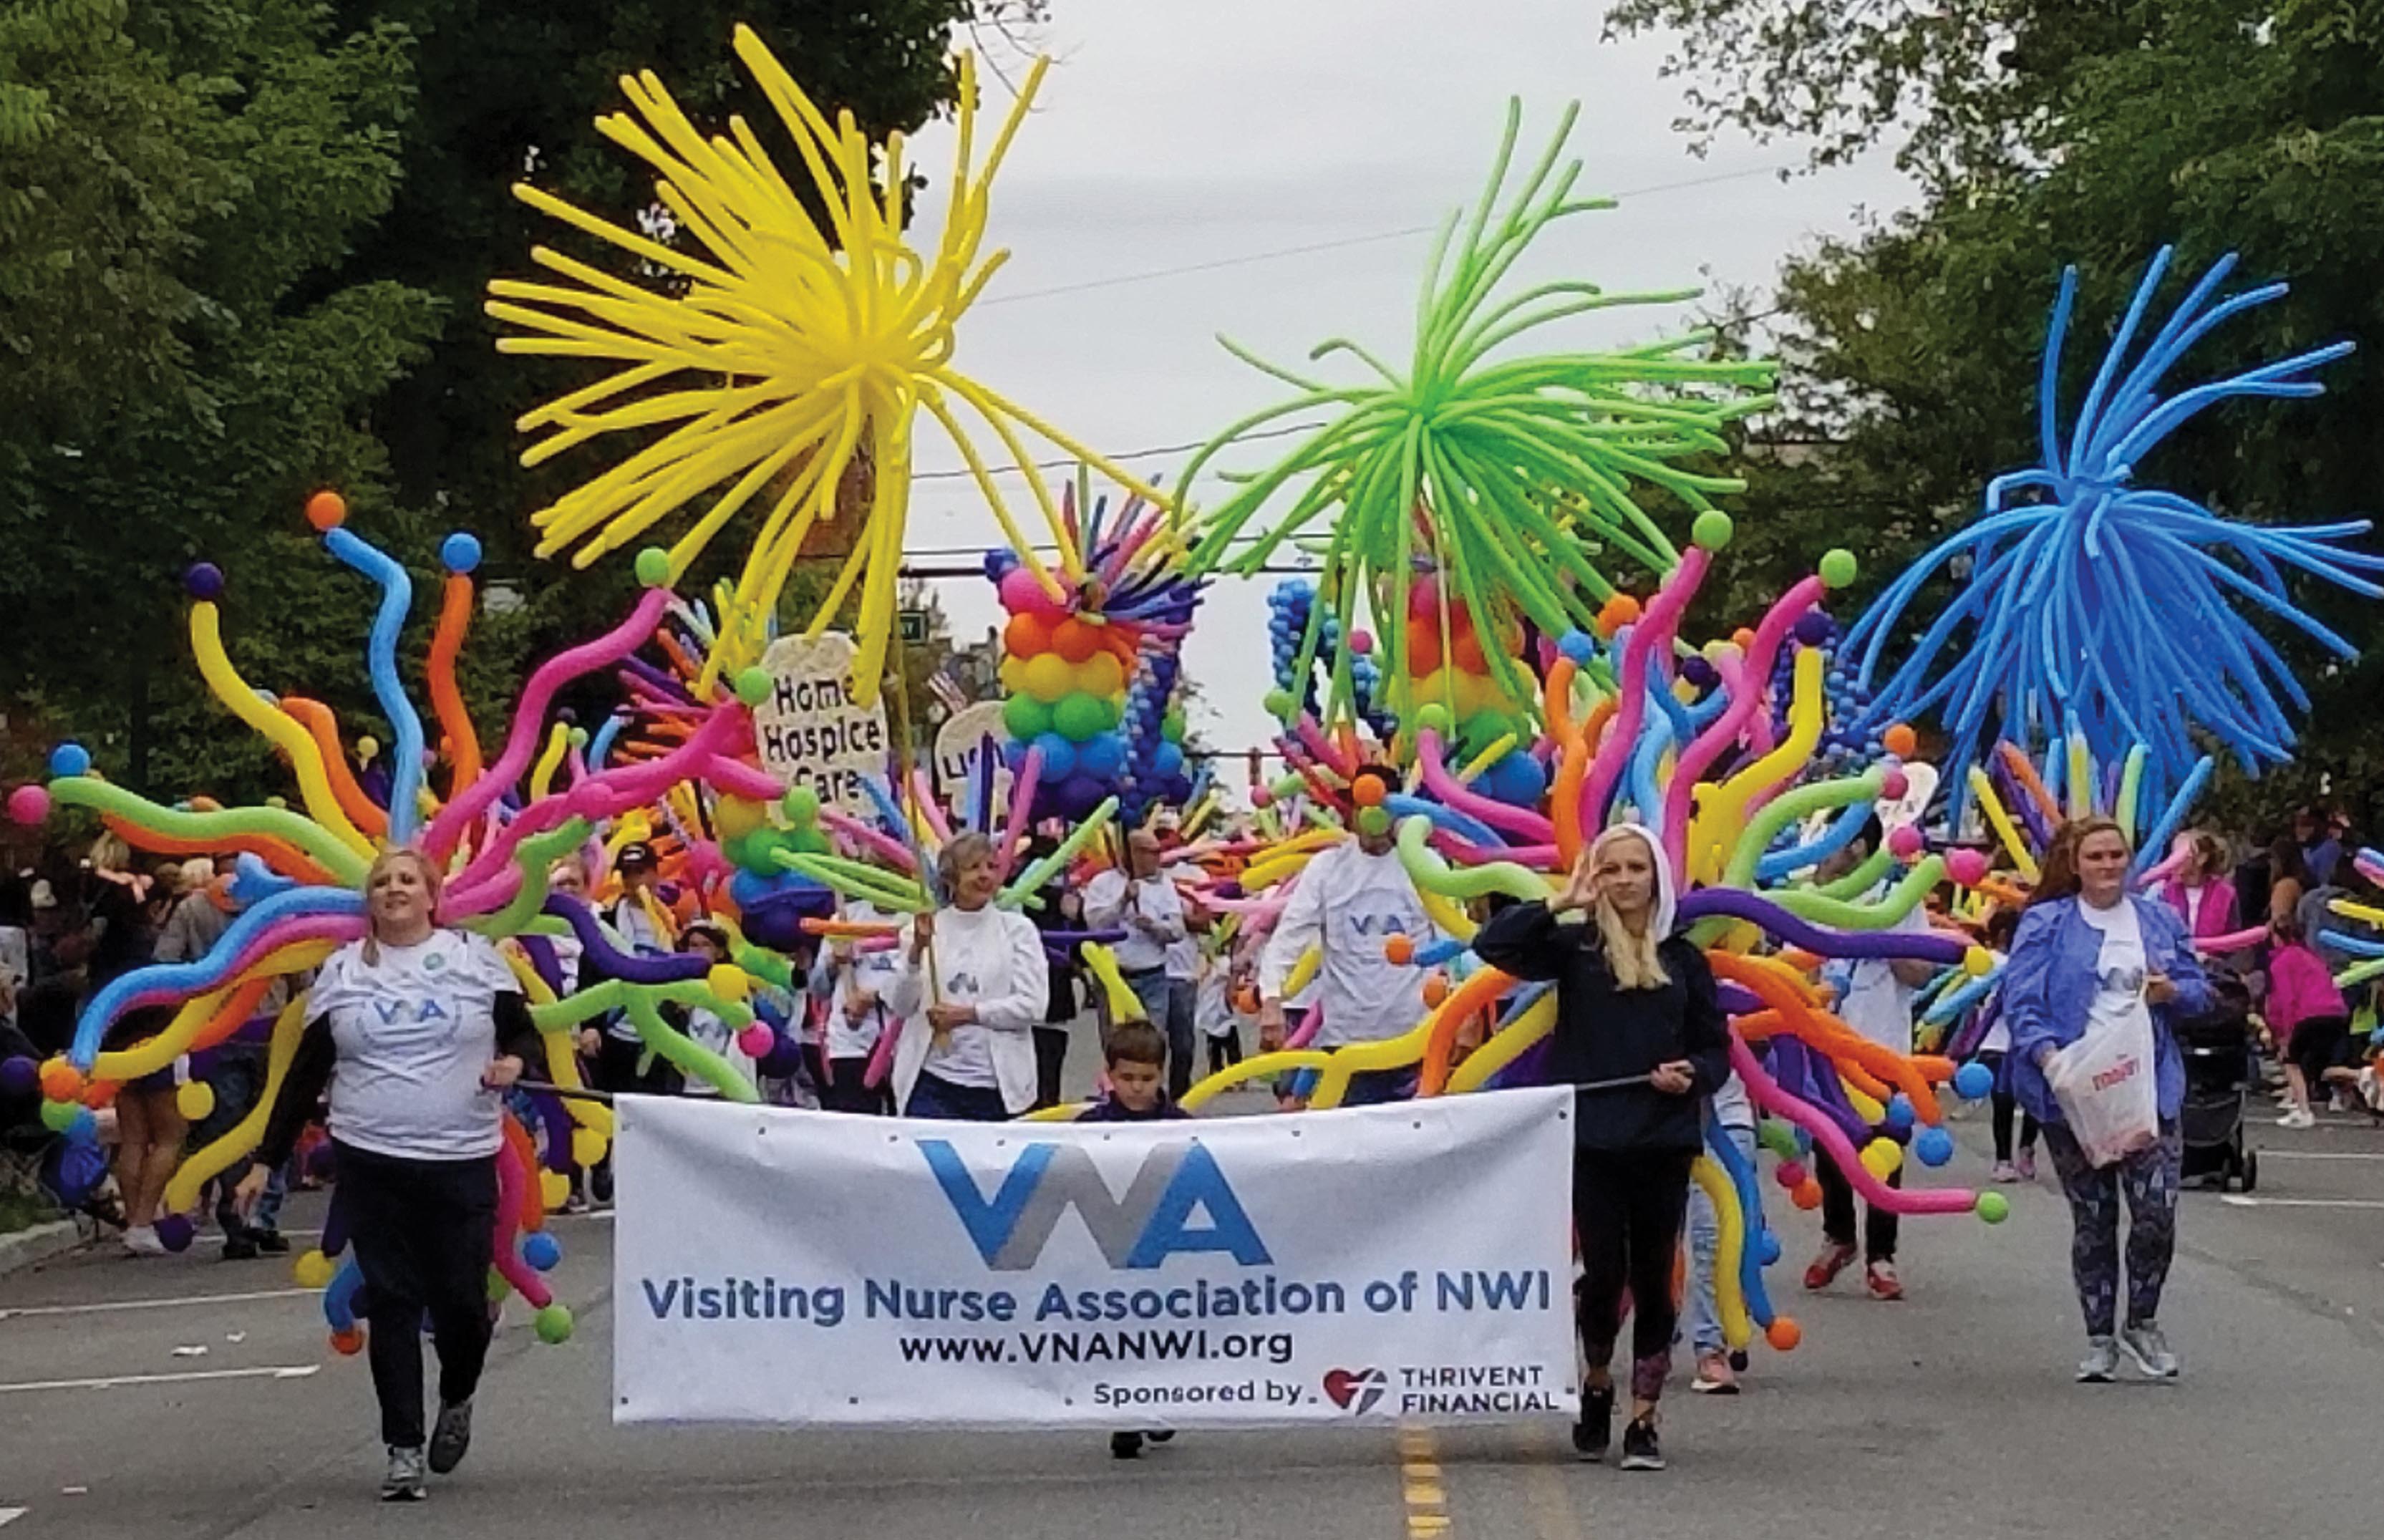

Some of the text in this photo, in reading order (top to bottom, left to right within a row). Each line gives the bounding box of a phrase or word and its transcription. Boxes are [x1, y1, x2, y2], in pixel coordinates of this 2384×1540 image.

[773, 674, 856, 716] Home
[763, 716, 881, 764] Hospice
[914, 1139, 1274, 1271] VNA
[641, 1270, 1550, 1327] Visiting Nurse Association of NWI
[899, 1330, 1294, 1365] www.VNANWI.org
[1095, 1380, 1255, 1408] Sponsored
[1400, 1365, 1544, 1388] THRIVENT
[1402, 1389, 1558, 1413] FINANCIAL
